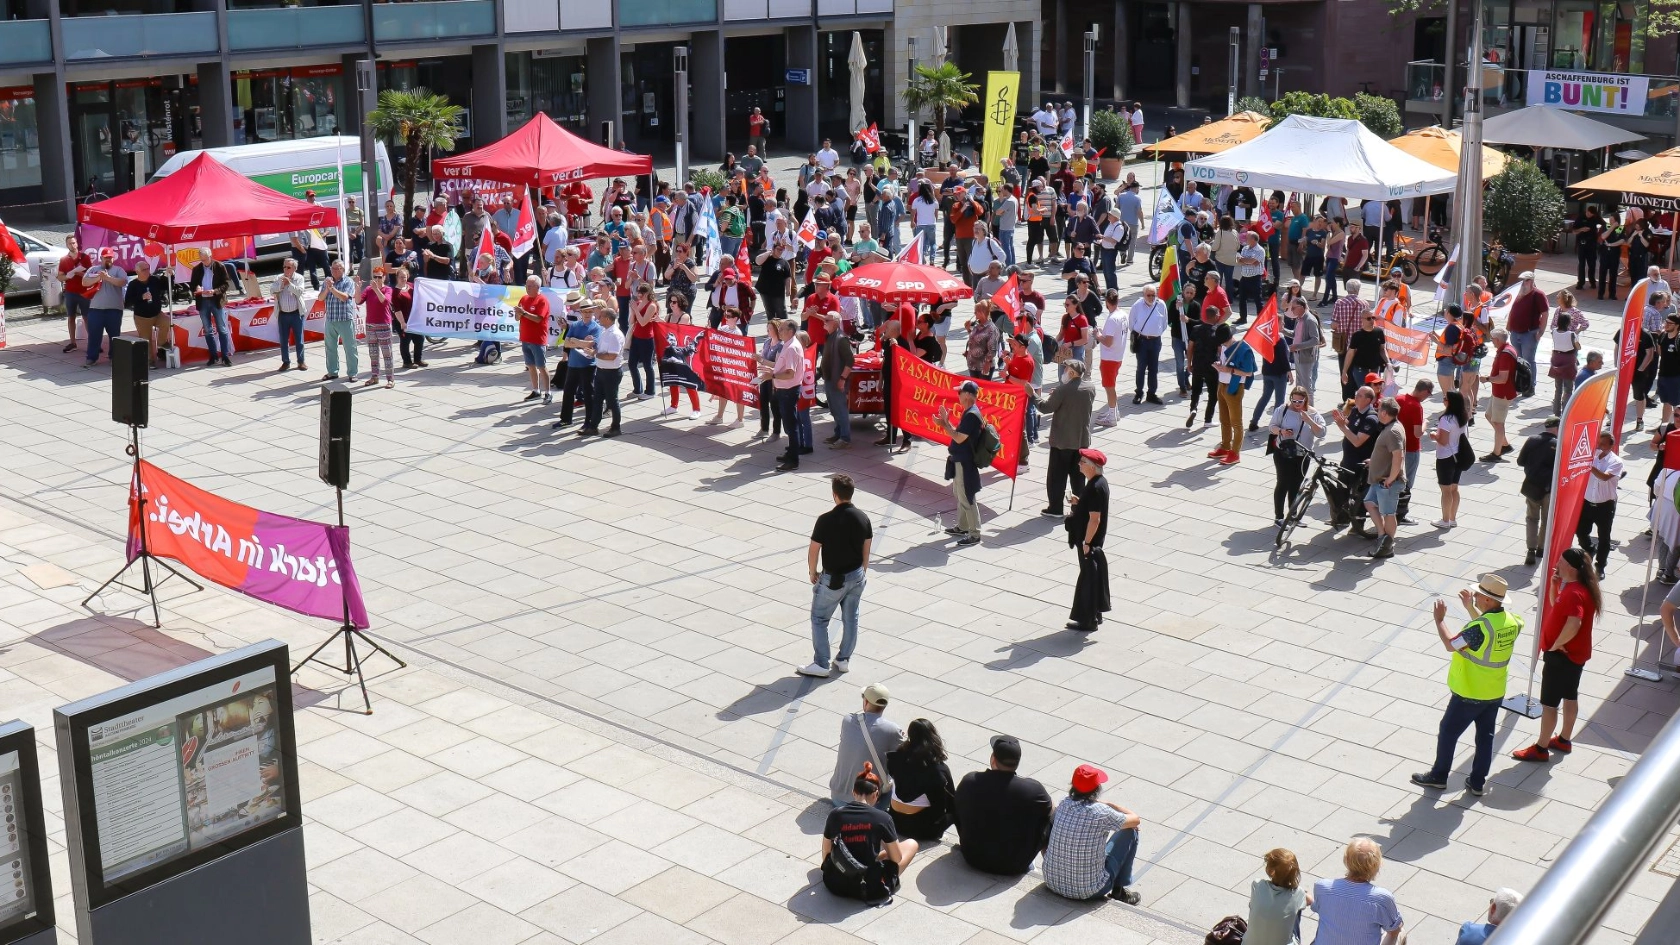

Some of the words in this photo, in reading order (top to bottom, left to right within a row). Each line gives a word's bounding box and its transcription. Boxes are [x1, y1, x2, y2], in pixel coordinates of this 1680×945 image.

[1545, 73, 1614, 84] ASCHAFFENBURG
[1544, 82, 1629, 109] BUNT!
[164, 100, 173, 140] wüstenrot
[292, 171, 338, 185] Europcar
[1192, 166, 1215, 179] VCD
[1389, 186, 1404, 196] VCD
[856, 277, 882, 288] SPD
[896, 281, 925, 290] SPD
[310, 311, 325, 319] DGB
[426, 302, 504, 317] Demokratie
[252, 318, 268, 326] DGB
[425, 317, 471, 331] Kampf
[474, 322, 515, 334] gegen
[104, 715, 145, 734] Stadttheater
